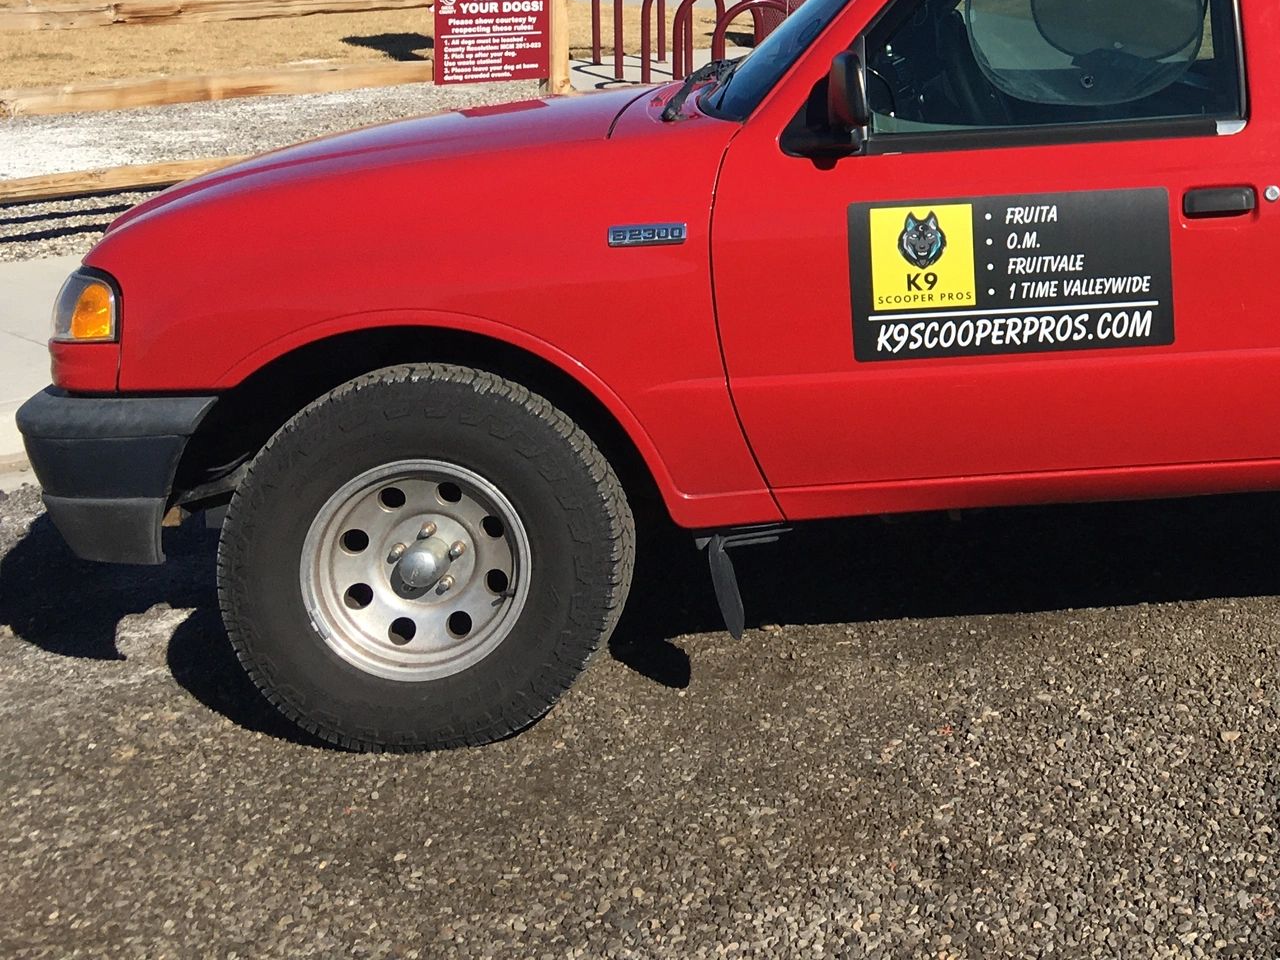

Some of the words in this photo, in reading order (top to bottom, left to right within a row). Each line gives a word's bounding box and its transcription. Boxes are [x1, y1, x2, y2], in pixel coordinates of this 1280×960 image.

[460, 2, 499, 14] YOUR
[503, 1, 543, 12] DOGS!
[496, 16, 526, 24] courtesy
[528, 16, 537, 24] by
[452, 26, 490, 34] respecting
[1005, 205, 1058, 224] FRUITA
[613, 227, 683, 241] B2300
[1006, 231, 1041, 249] O.M.
[1007, 254, 1084, 275] FRUITVALE
[906, 272, 938, 292] K9
[1009, 283, 1016, 300] 1
[1021, 281, 1058, 299] TIME
[1063, 276, 1151, 297] VALLEYWIDE
[878, 293, 935, 305] SCOOPER
[940, 291, 973, 302] PROS
[876, 310, 1153, 354] K9SCOOPERPROS.COM
